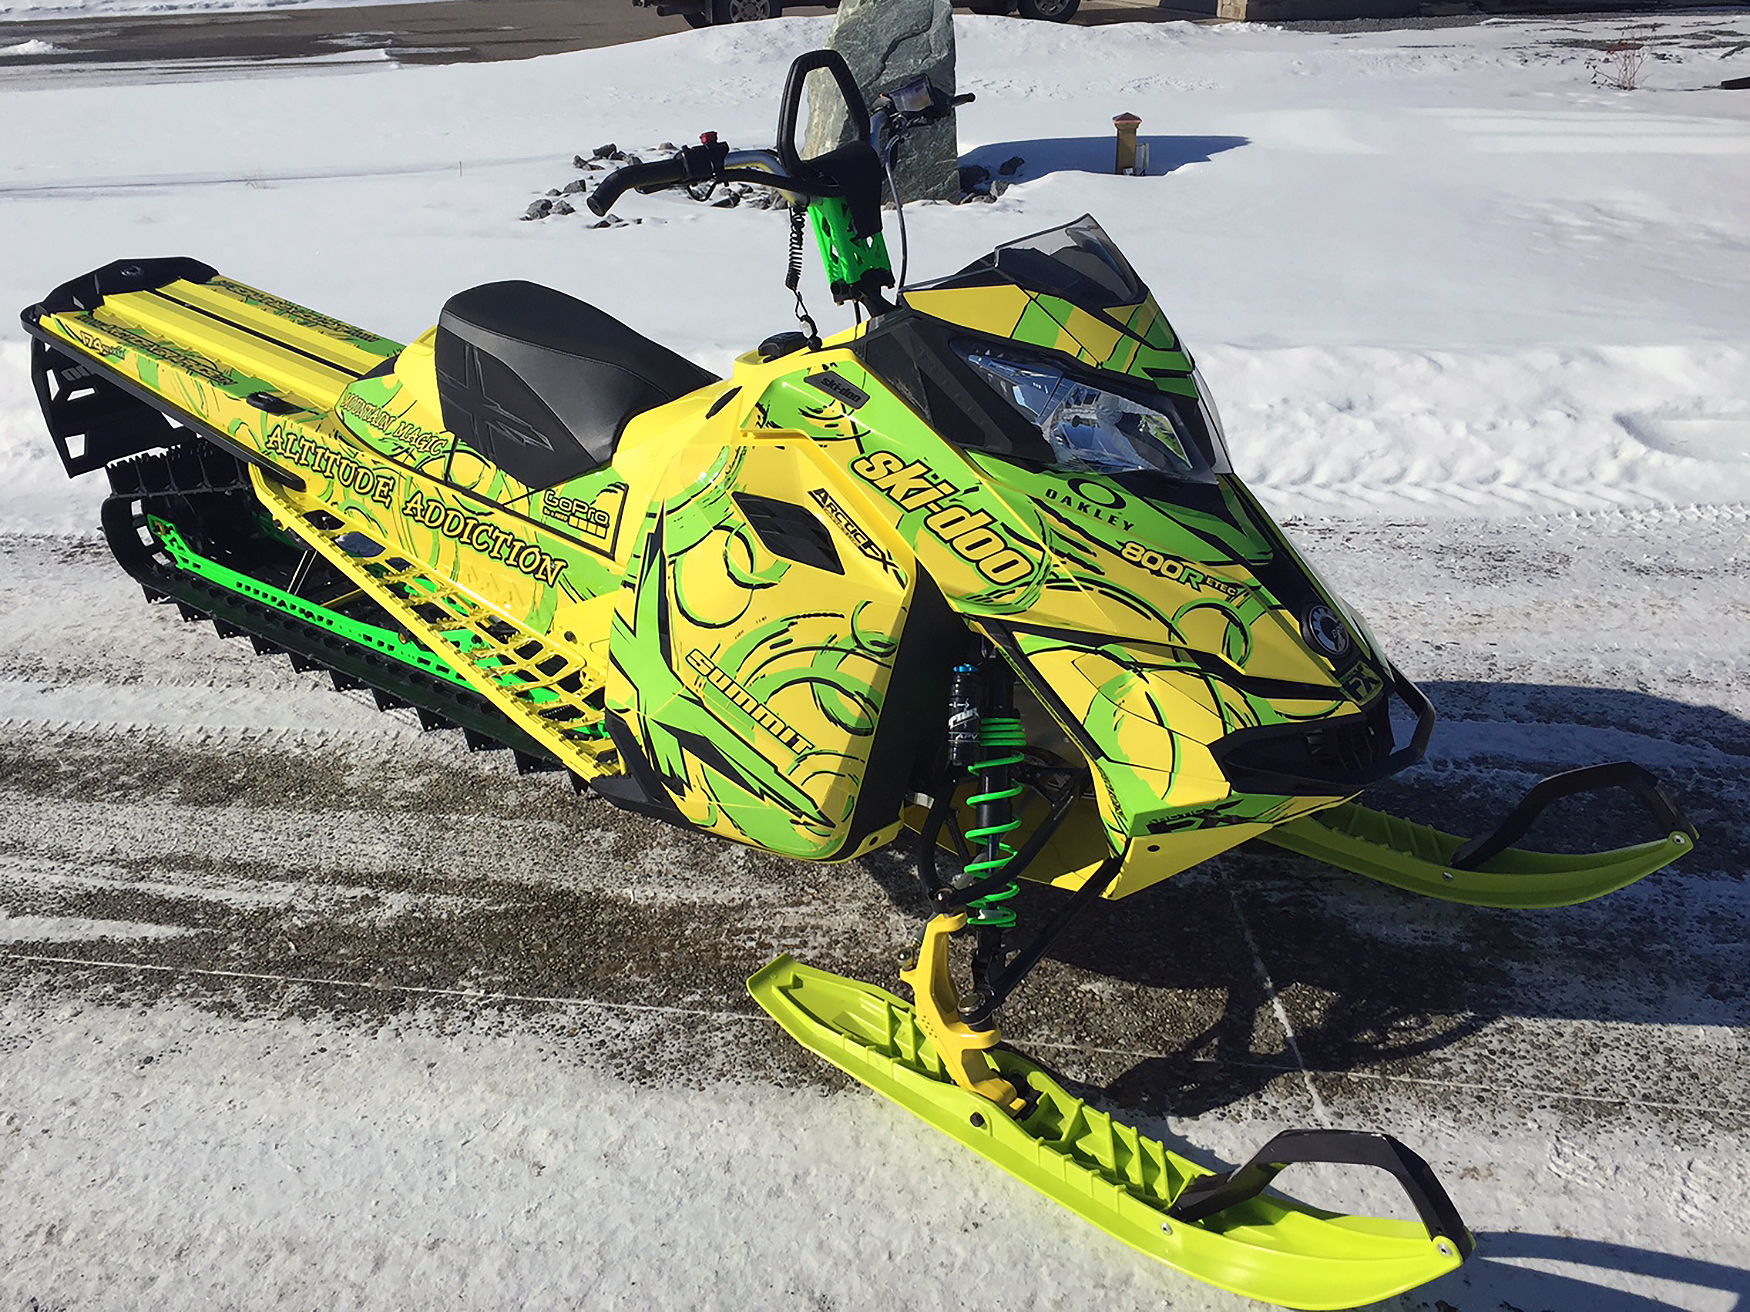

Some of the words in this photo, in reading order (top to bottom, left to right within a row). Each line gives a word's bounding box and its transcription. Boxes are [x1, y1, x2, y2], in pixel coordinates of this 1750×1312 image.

[820, 377, 861, 403] ski-doo
[393, 420, 448, 455] MAGIC
[265, 425, 396, 507] ALTITUDE
[403, 491, 567, 588] ADDICTION
[544, 487, 610, 526] GoPro
[851, 450, 1034, 586] ski-doo
[1045, 488, 1134, 531] OAKLEY
[685, 648, 815, 756] SUMMIT
